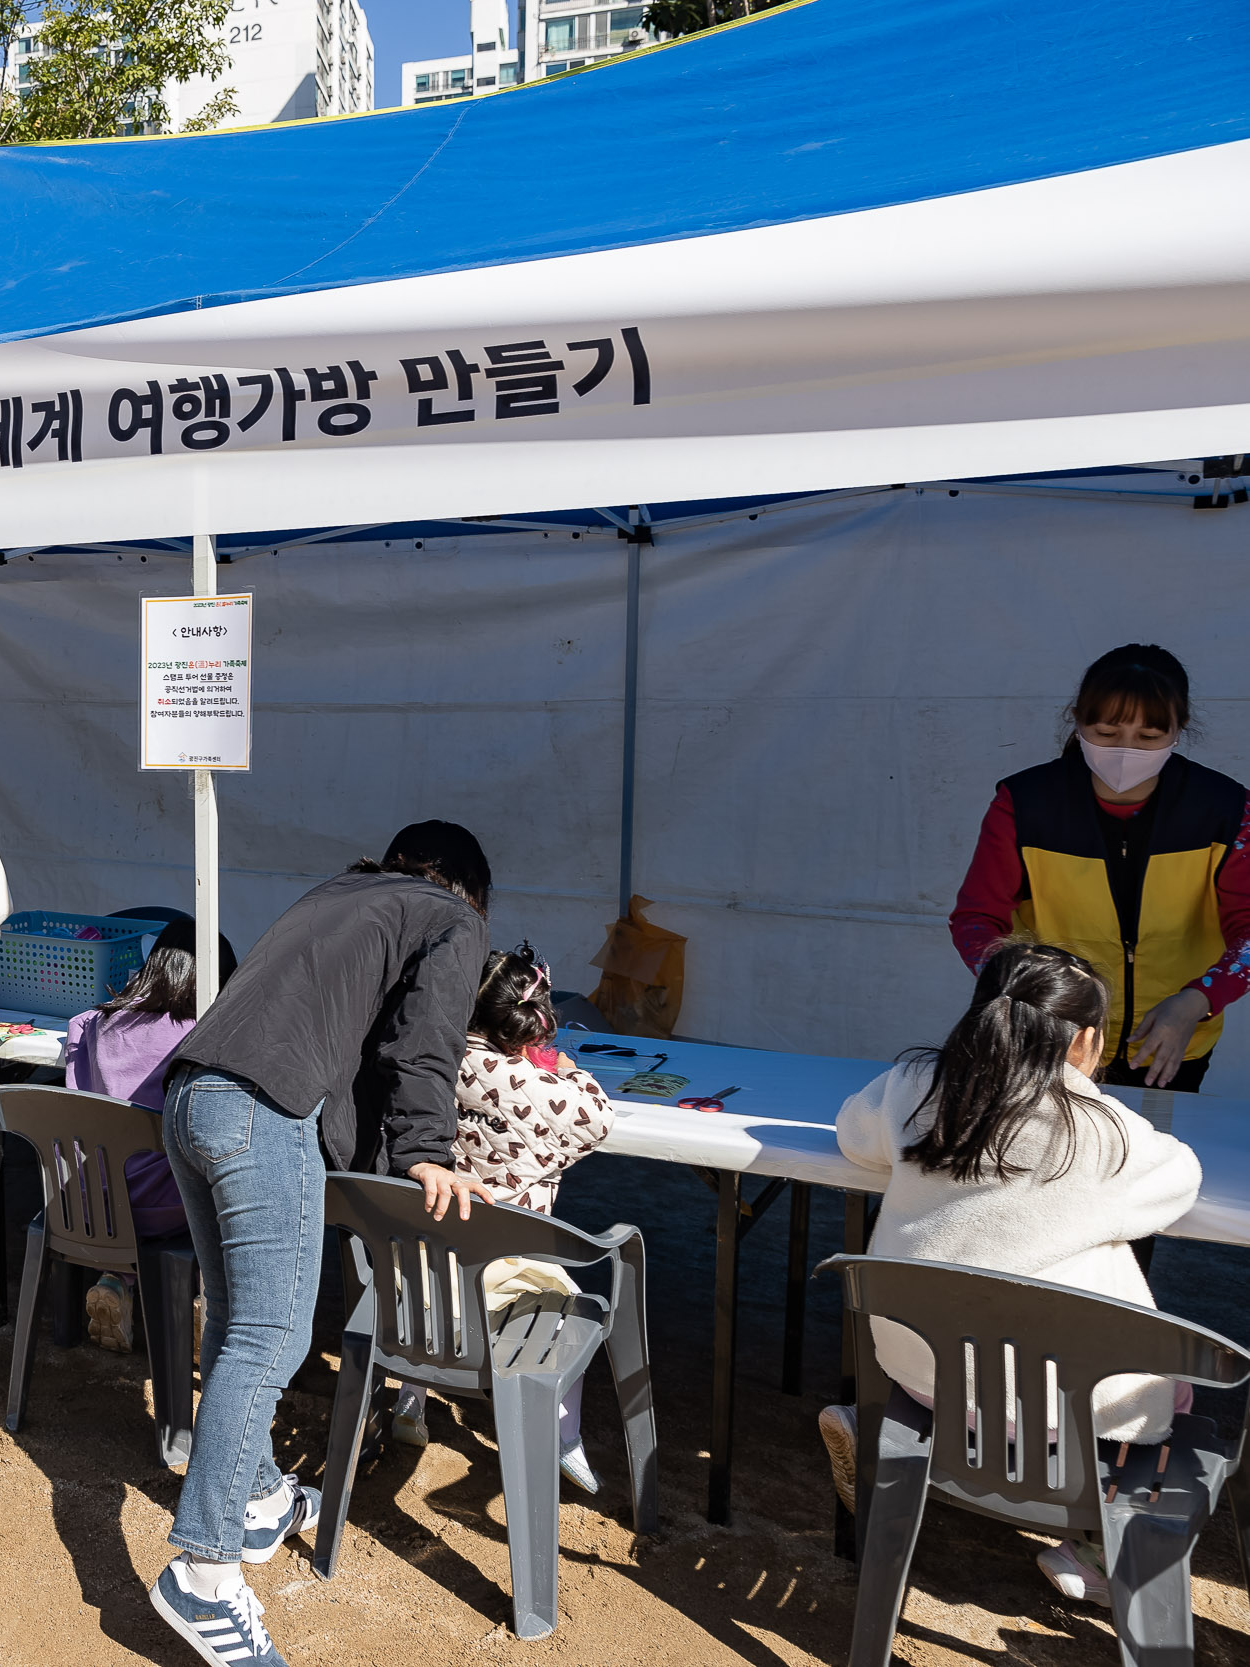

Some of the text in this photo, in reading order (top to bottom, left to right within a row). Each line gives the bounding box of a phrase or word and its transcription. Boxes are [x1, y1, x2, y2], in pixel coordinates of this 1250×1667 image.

[229, 23, 263, 44] 212
[107, 359, 379, 455] 여행가방
[398, 325, 652, 428] 만들기
[148, 660, 173, 670] 2023년
[222, 659, 247, 668] 가족축제
[162, 673, 184, 682] 스탬프
[185, 673, 199, 681] 투어
[199, 672, 213, 682] 선물
[164, 685, 232, 694] 공직선거법에 의거하여
